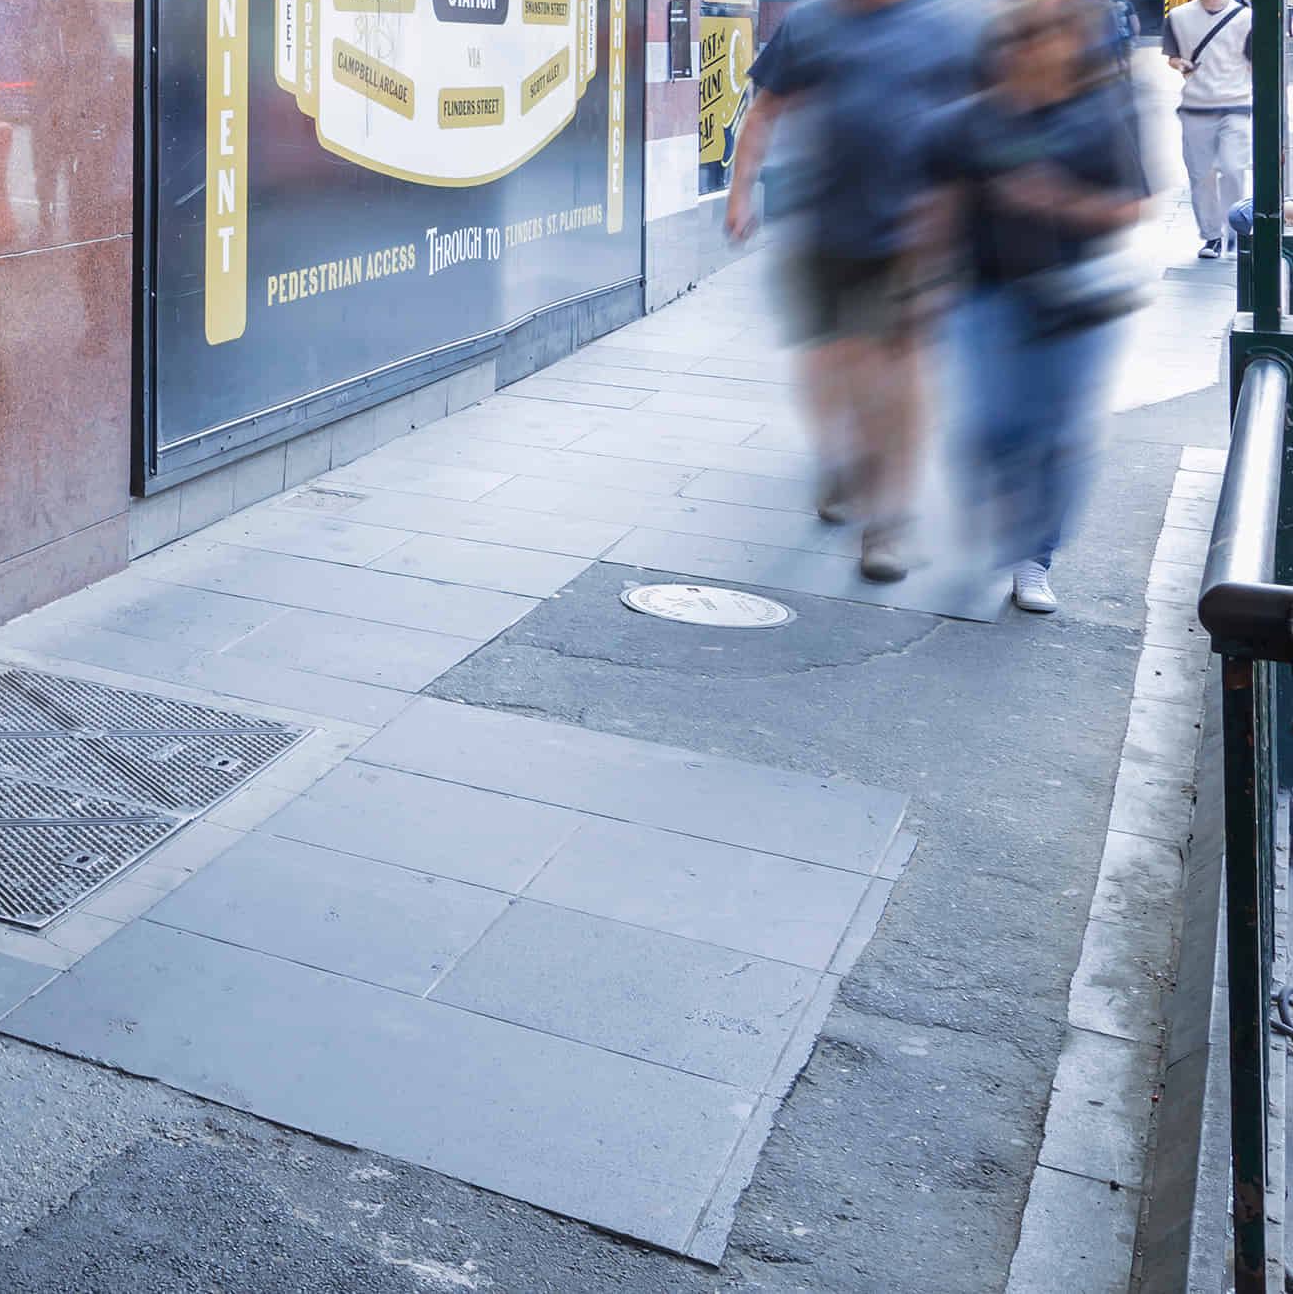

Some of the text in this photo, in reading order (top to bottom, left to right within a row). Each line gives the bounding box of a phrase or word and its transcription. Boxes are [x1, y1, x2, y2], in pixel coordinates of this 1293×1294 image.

[337, 49, 409, 106] CAMPBELL ARCADE
[466, 46, 482, 69] VIA
[443, 97, 500, 119] FLINDERS STREET
[425, 225, 501, 276] THROUGH TO
[504, 217, 544, 249] FLINDERS
[267, 243, 416, 306] PEDESTRIAN ACCESS
